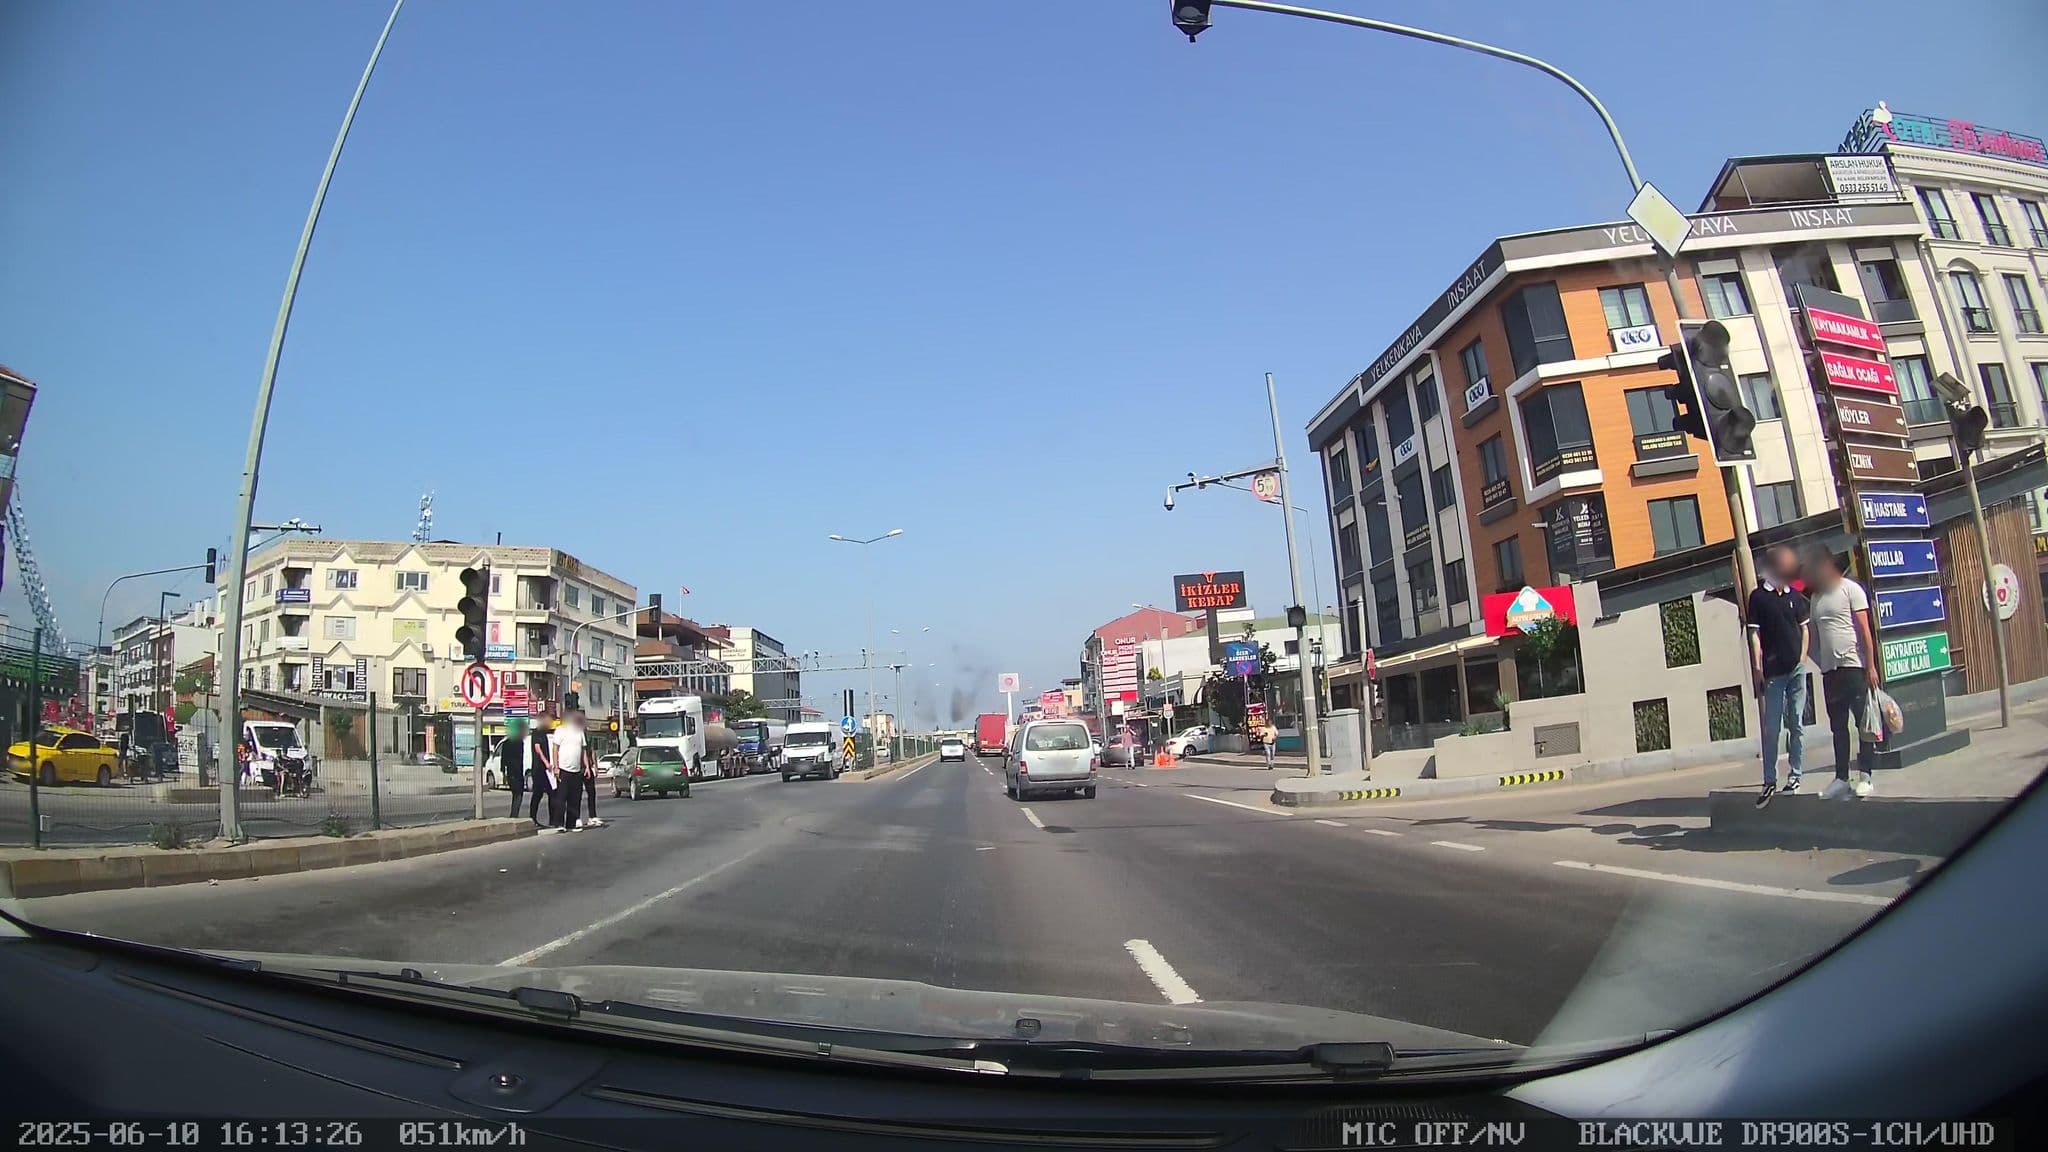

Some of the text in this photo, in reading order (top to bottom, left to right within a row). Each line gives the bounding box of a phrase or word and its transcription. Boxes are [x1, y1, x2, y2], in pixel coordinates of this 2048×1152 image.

[1830, 159, 1885, 169] ARSLAN HUKUK
[1840, 183, 1888, 193] 0533 255 51 49
[1603, 215, 1738, 245] YELKAYA
[1812, 316, 1870, 341] KAYMAKAMLIK
[1370, 325, 1423, 382] YELKENKAYA
[1827, 360, 1879, 384] SAĞLIK OCAĞI
[1839, 405, 1871, 426] KÖYLER
[1874, 502, 1908, 518] HASTANE
[1871, 550, 1905, 567] OKULLAR
[1180, 583, 1240, 598] İKİZLER
[1187, 594, 1235, 609] KEBAP
[1880, 602, 1894, 618] PTT
[1115, 637, 1136, 645] ONUR
[1885, 640, 1928, 659] BAYRAKTEPE
[1886, 657, 1911, 677] PİKNİK
